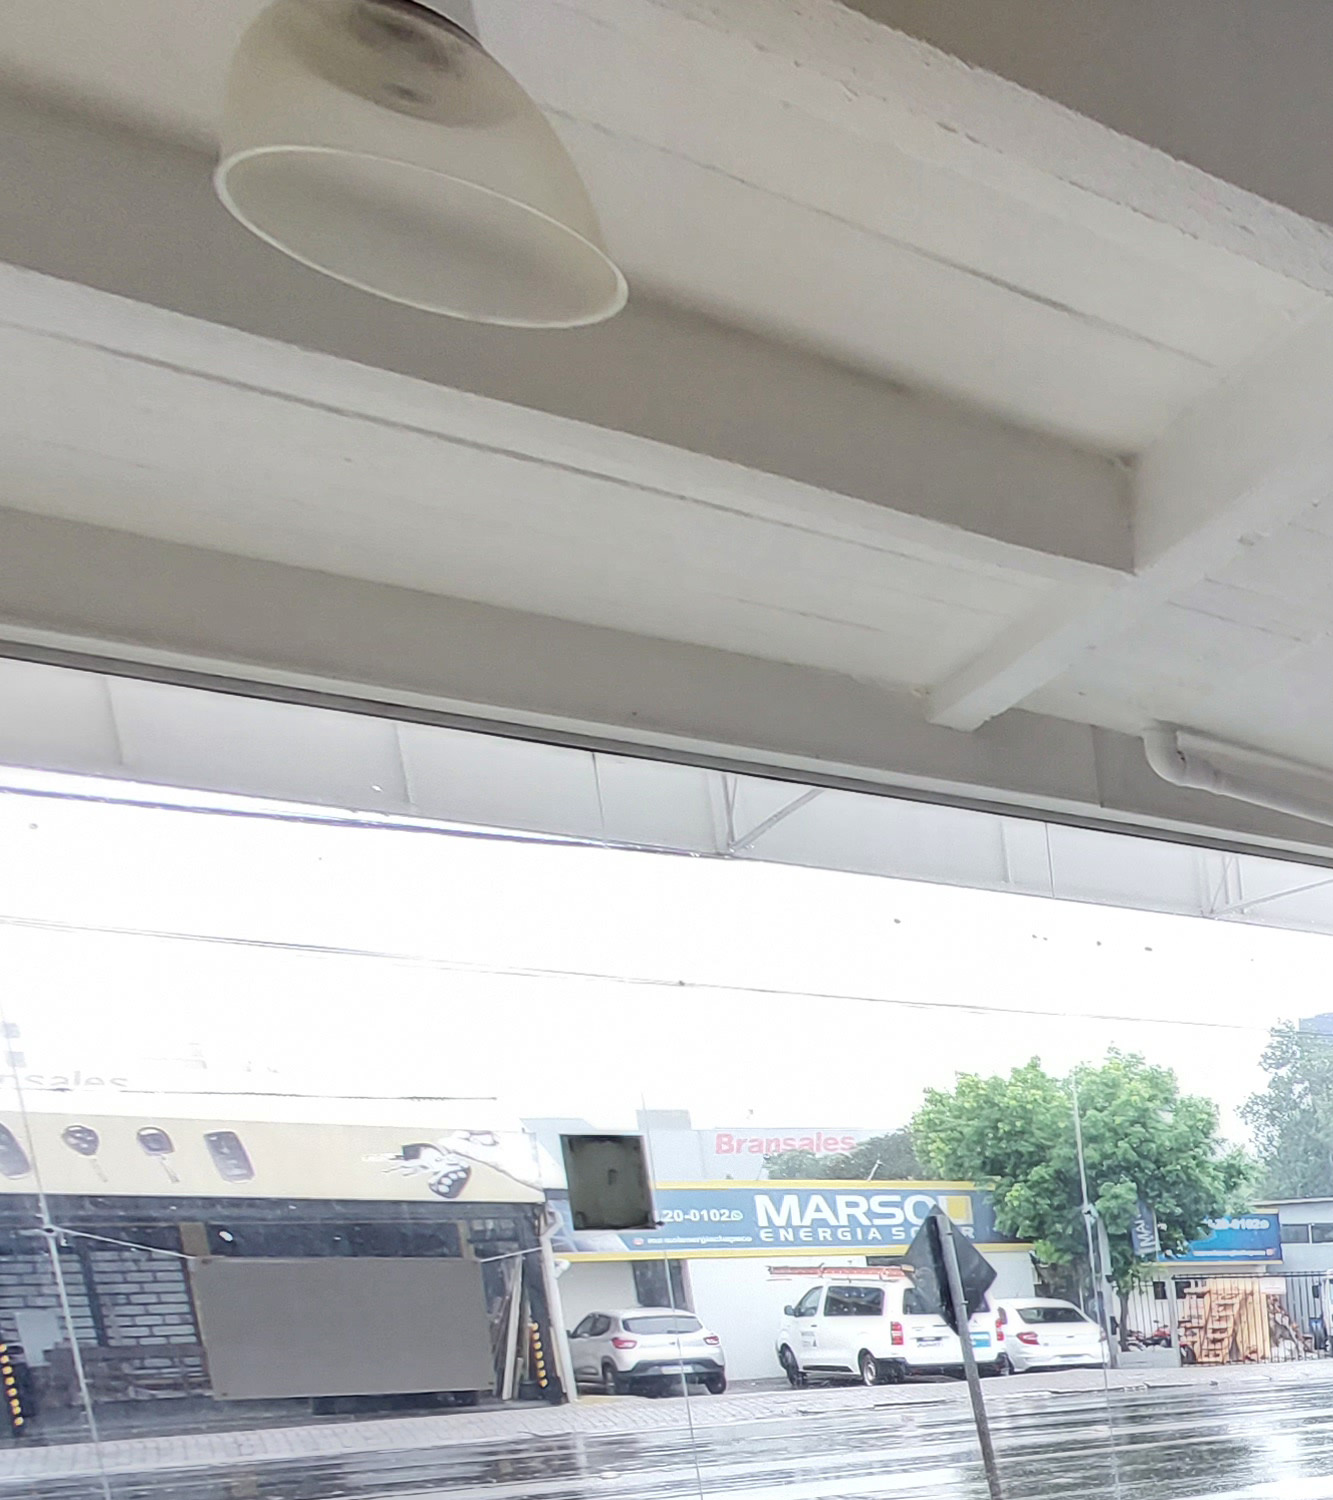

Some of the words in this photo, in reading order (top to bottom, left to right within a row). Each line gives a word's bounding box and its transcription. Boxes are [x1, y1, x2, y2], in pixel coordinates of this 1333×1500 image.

[715, 1131, 856, 1155] Bransales
[657, 1208, 731, 1222] 20-0102
[760, 1227, 887, 1242] ENERGIA
